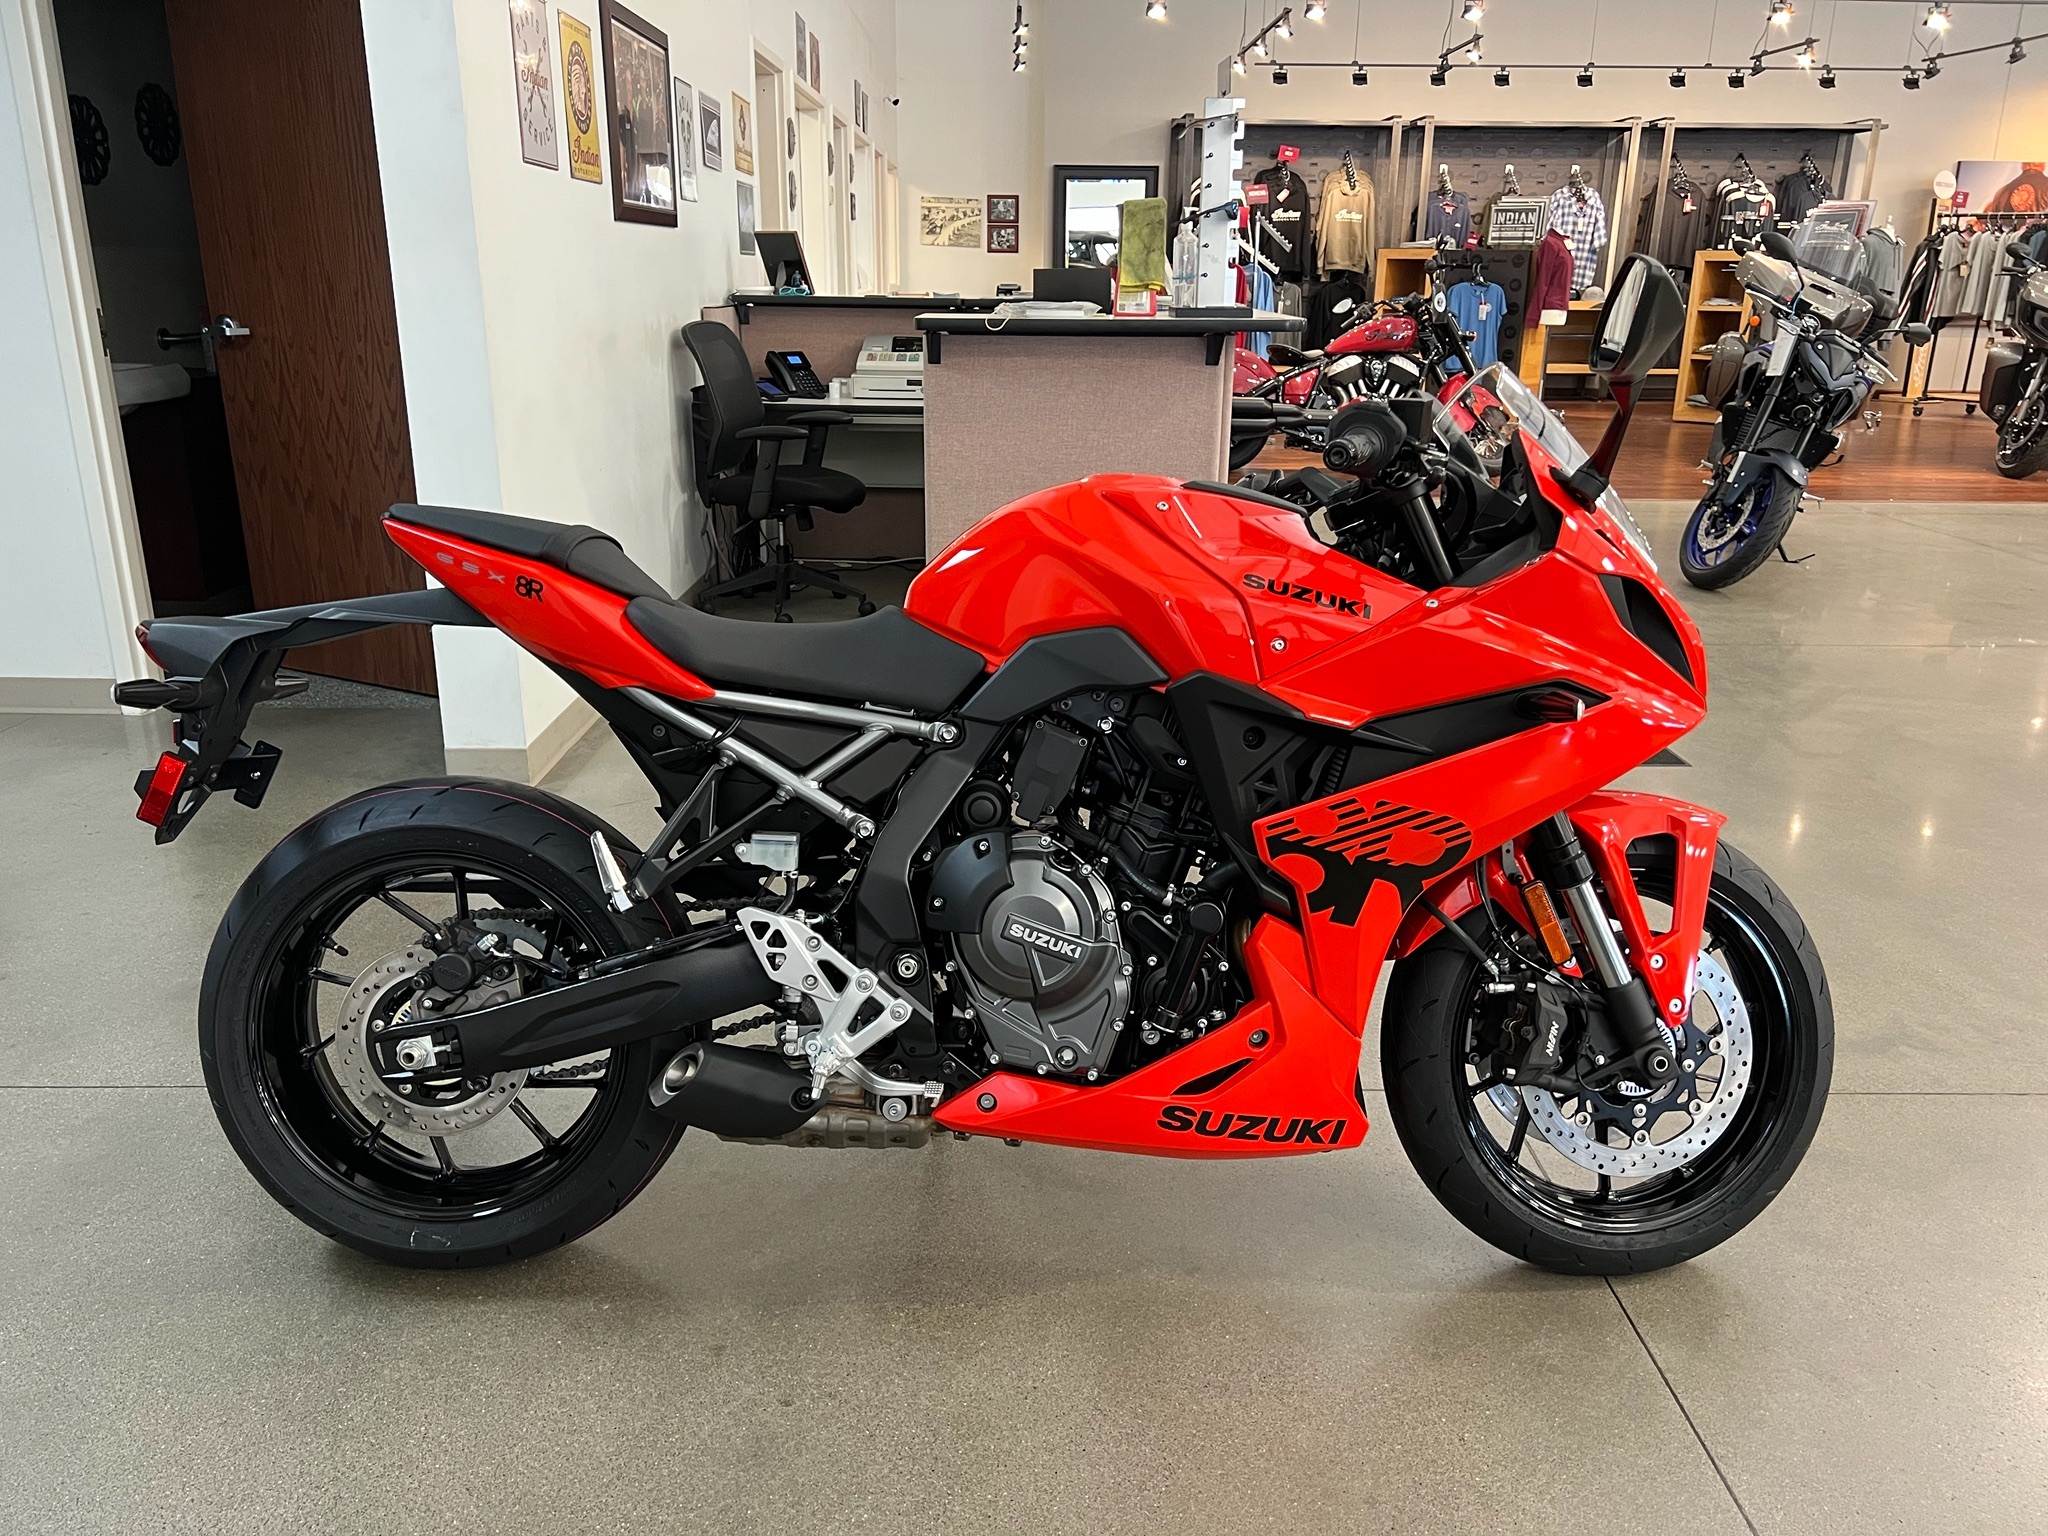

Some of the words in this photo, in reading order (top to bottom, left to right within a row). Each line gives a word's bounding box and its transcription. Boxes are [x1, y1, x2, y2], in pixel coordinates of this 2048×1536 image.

[515, 10, 540, 39] PARTS
[521, 63, 549, 91] Indian
[522, 107, 553, 146] SERVICE
[572, 135, 600, 168] Indian
[1493, 211, 1536, 224] INDIAN
[514, 574, 544, 603] 8R
[1242, 573, 1373, 620] SUZUKI
[1009, 923, 1082, 959] SUZUKI
[1156, 1105, 1348, 1144] SUZUKI
